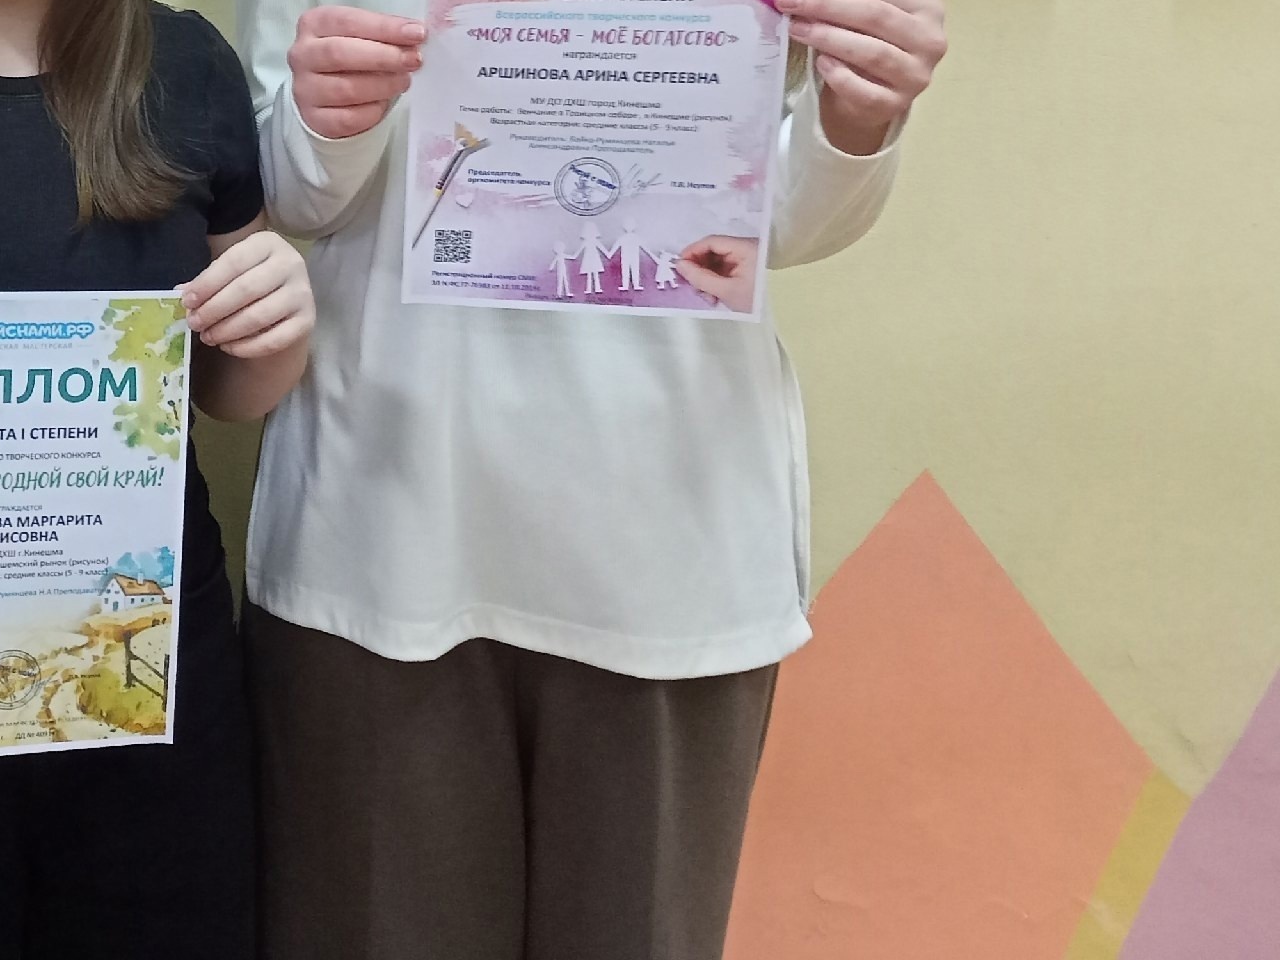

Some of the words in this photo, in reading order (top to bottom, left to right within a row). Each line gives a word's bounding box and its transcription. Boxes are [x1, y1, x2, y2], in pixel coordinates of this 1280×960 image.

[495, 10, 584, 20] Всероссийского
[588, 13, 657, 22] творческого
[659, 15, 711, 23] конкурса
[467, 27, 512, 44] «МОЯ
[516, 27, 569, 45] СЕМЬЯ
[592, 26, 628, 44] МОЁ
[631, 30, 741, 47] БОГАТСТВО»
[563, 51, 637, 60] награждается
[477, 66, 570, 81] АРШИНОВА
[573, 69, 629, 82] АРИНА
[633, 71, 720, 84] СЕРГЕЕВНА
[588, 100, 616, 108] город
[618, 100, 661, 108] Кинешма
[22, 342, 73, 350] МАСТЕРСКАЯ
[30, 427, 98, 439] СТЕПЕНИ
[5, 452, 59, 461] ТВОРЧЕСКОГО
[61, 451, 101, 459] КОНКУРСА
[66, 465, 109, 488] СВОЙ
[113, 464, 165, 488] КРАЙ!
[16, 514, 103, 528] МАРГАРИТА
[40, 559, 67, 568] рынок
[69, 557, 109, 566] (рисунок)
[4, 572, 36, 580] средние
